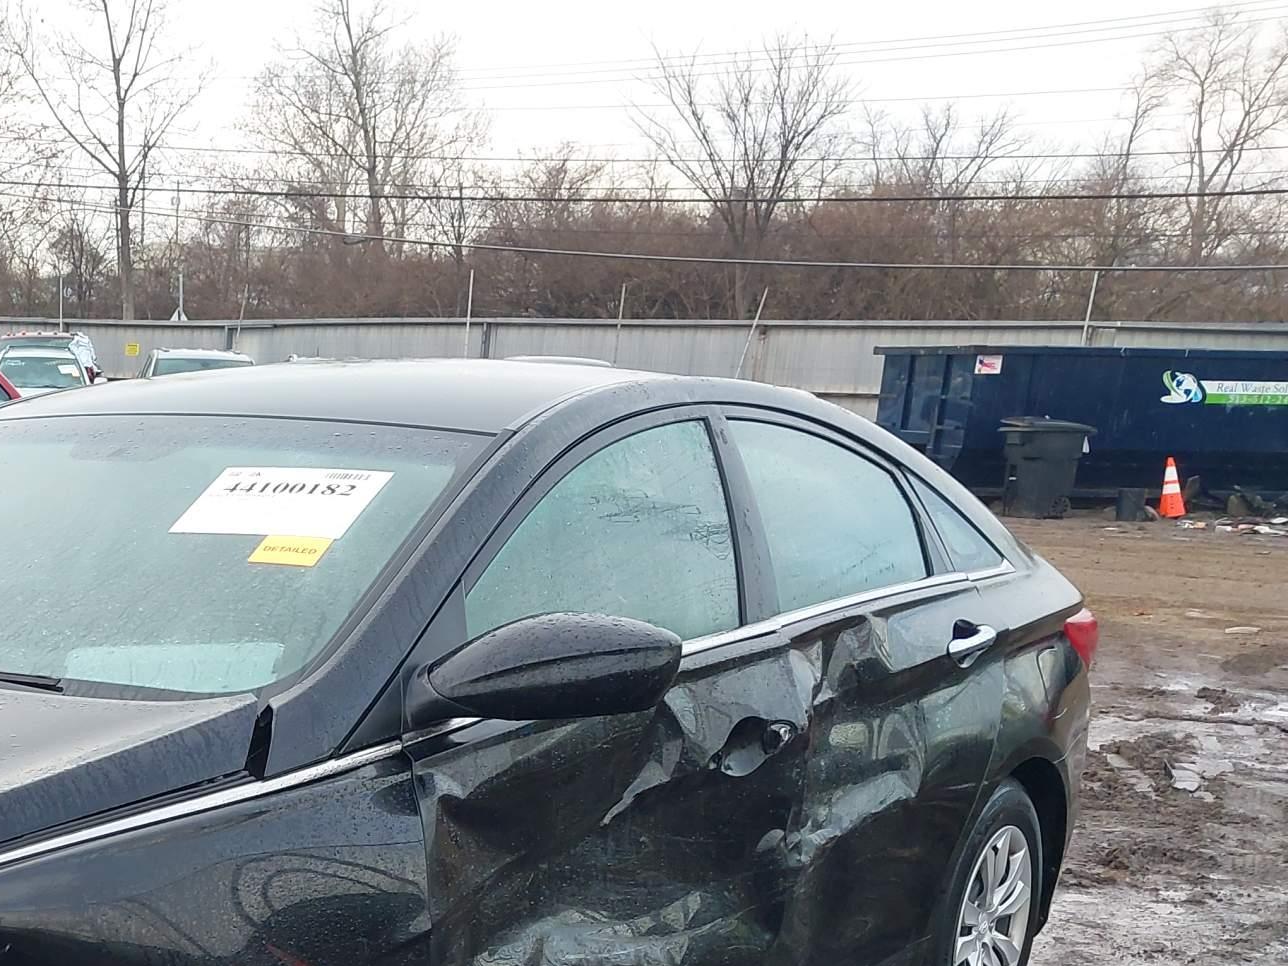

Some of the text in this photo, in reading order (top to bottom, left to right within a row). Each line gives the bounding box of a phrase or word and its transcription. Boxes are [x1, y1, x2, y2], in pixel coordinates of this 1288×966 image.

[1216, 383, 1239, 393] Real
[223, 481, 357, 497] 44100182
[263, 545, 317, 555] DETAILED
